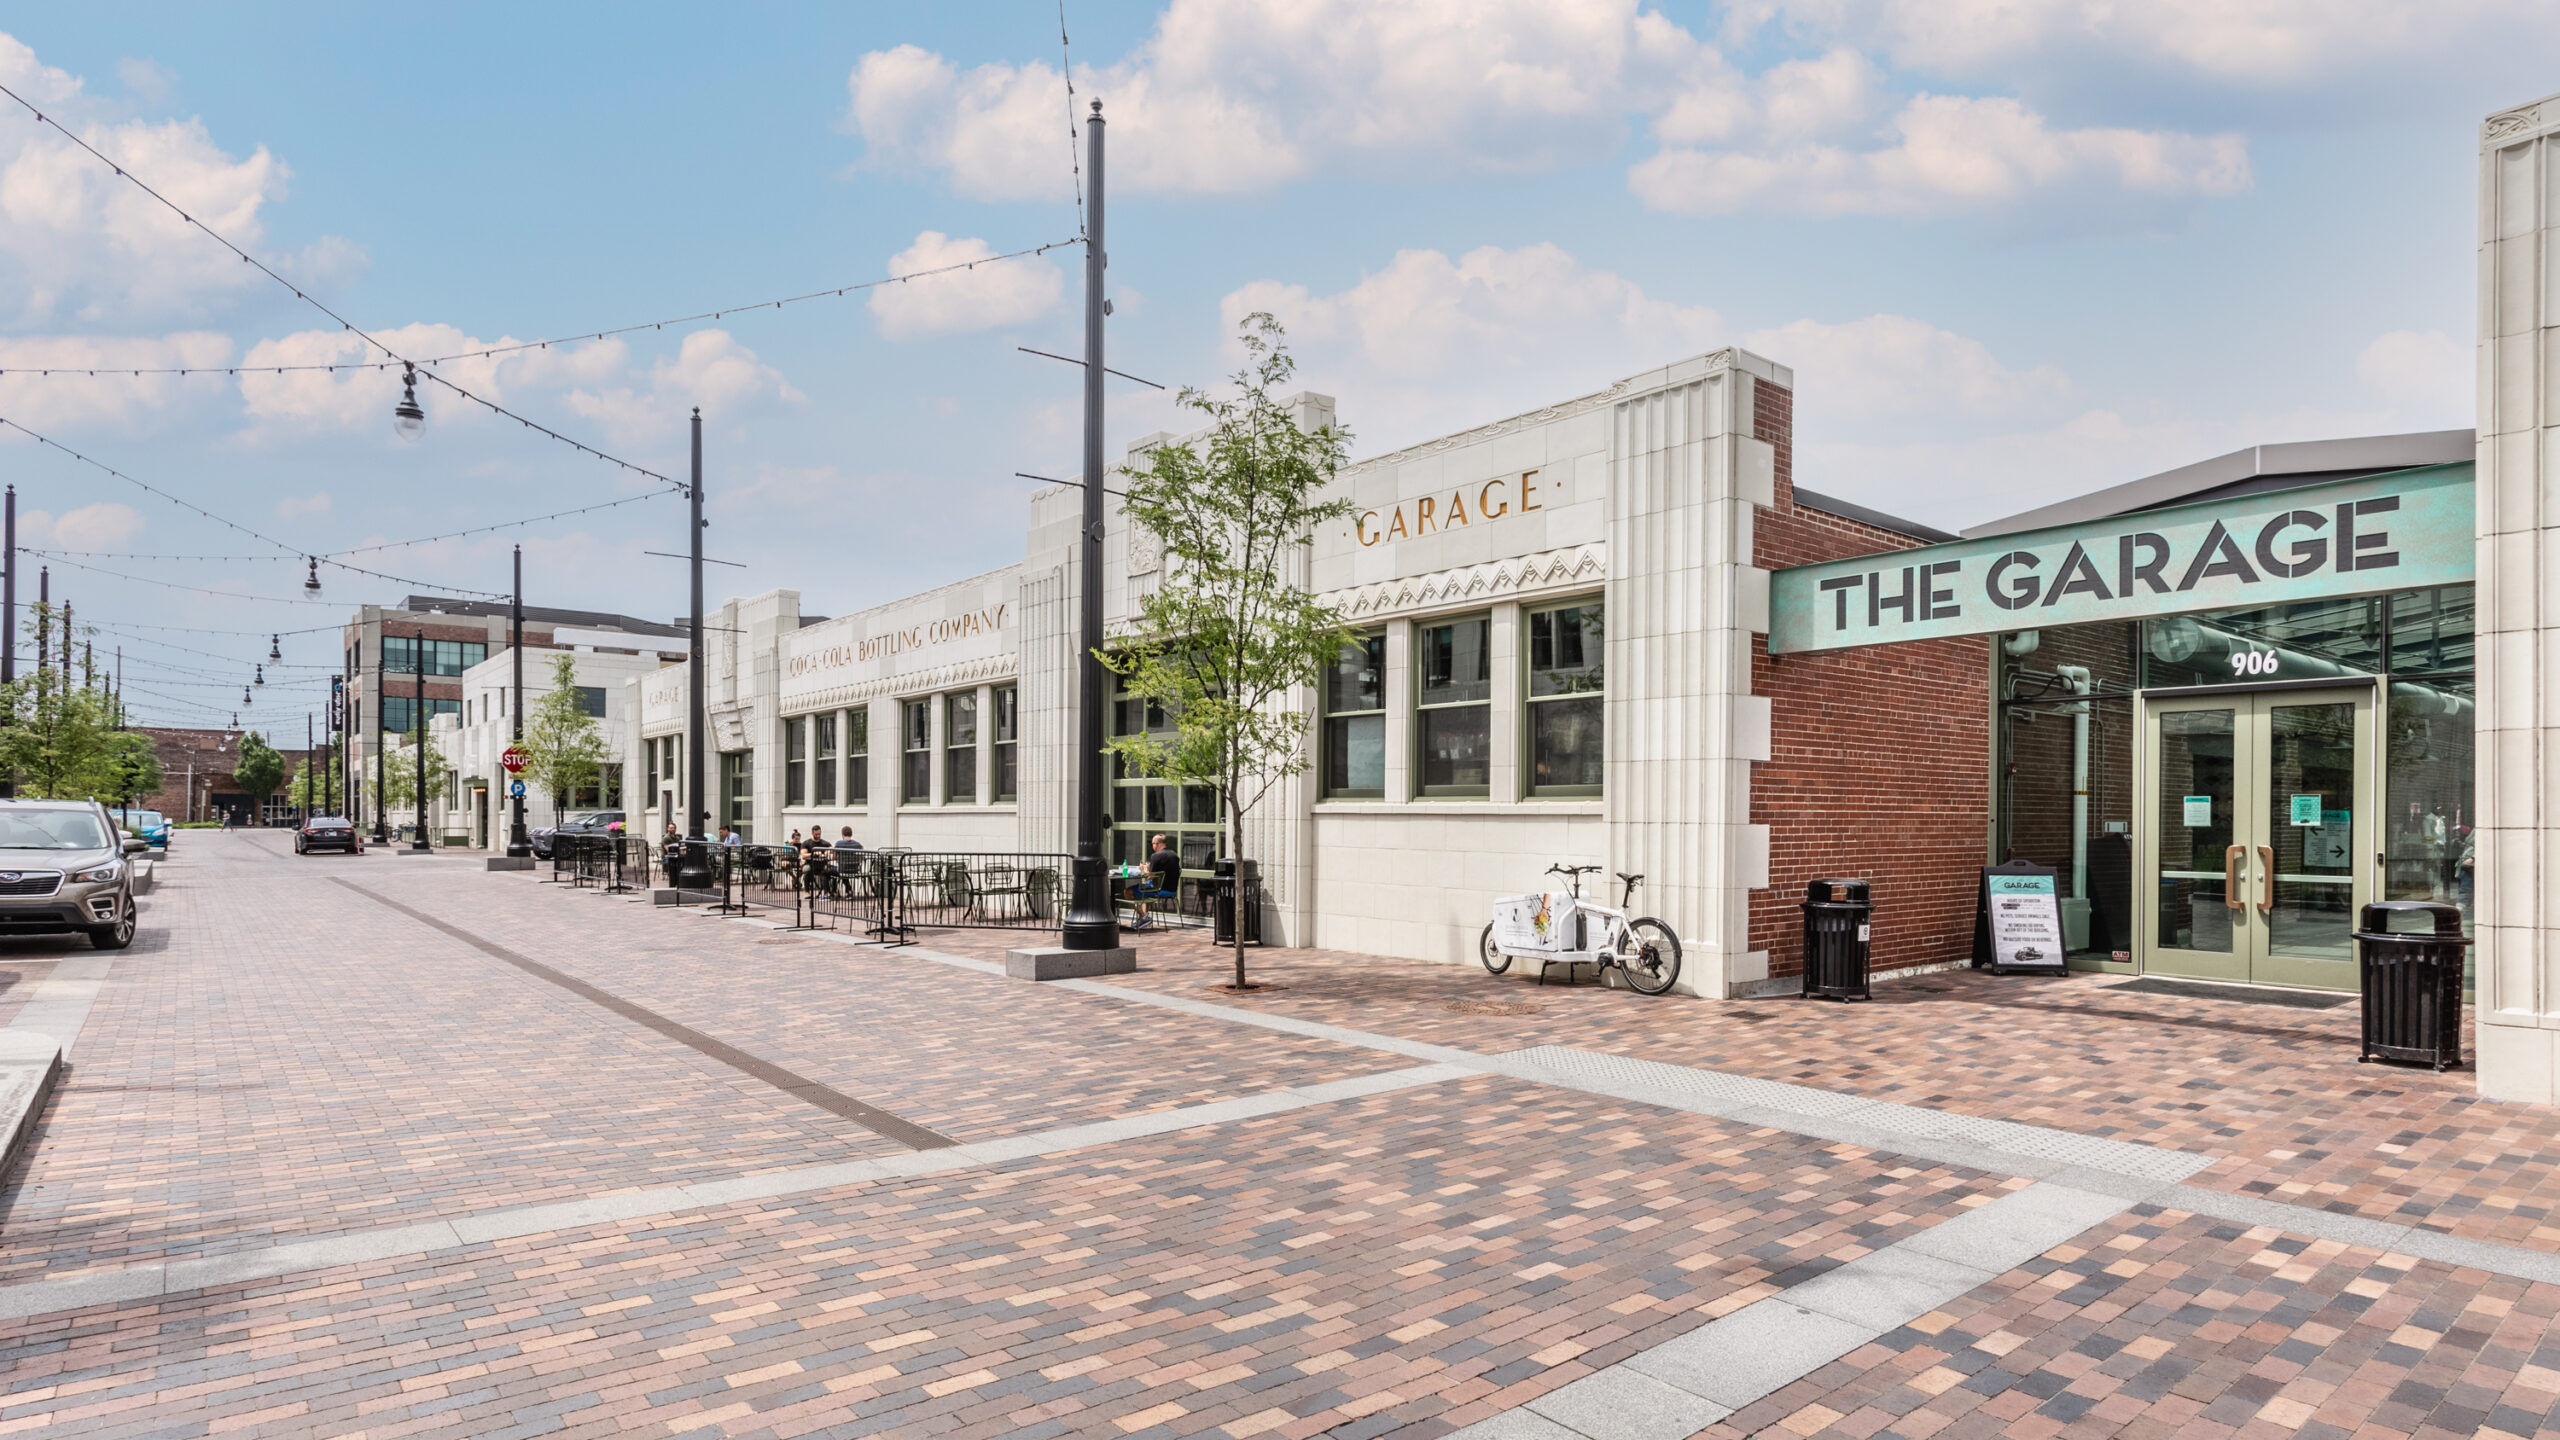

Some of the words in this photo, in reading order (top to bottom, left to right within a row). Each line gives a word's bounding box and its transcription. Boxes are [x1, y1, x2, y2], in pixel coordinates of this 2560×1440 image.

[1357, 469, 1542, 547] GARAGE
[1819, 559, 1961, 632] THE
[1985, 495, 2401, 612] GARAGE
[859, 626, 922, 662] BOTTLING
[929, 604, 1006, 645] COMPANY
[2231, 650, 2278, 676] 906
[504, 754, 532, 766] STOP
[514, 783, 523, 794] P
